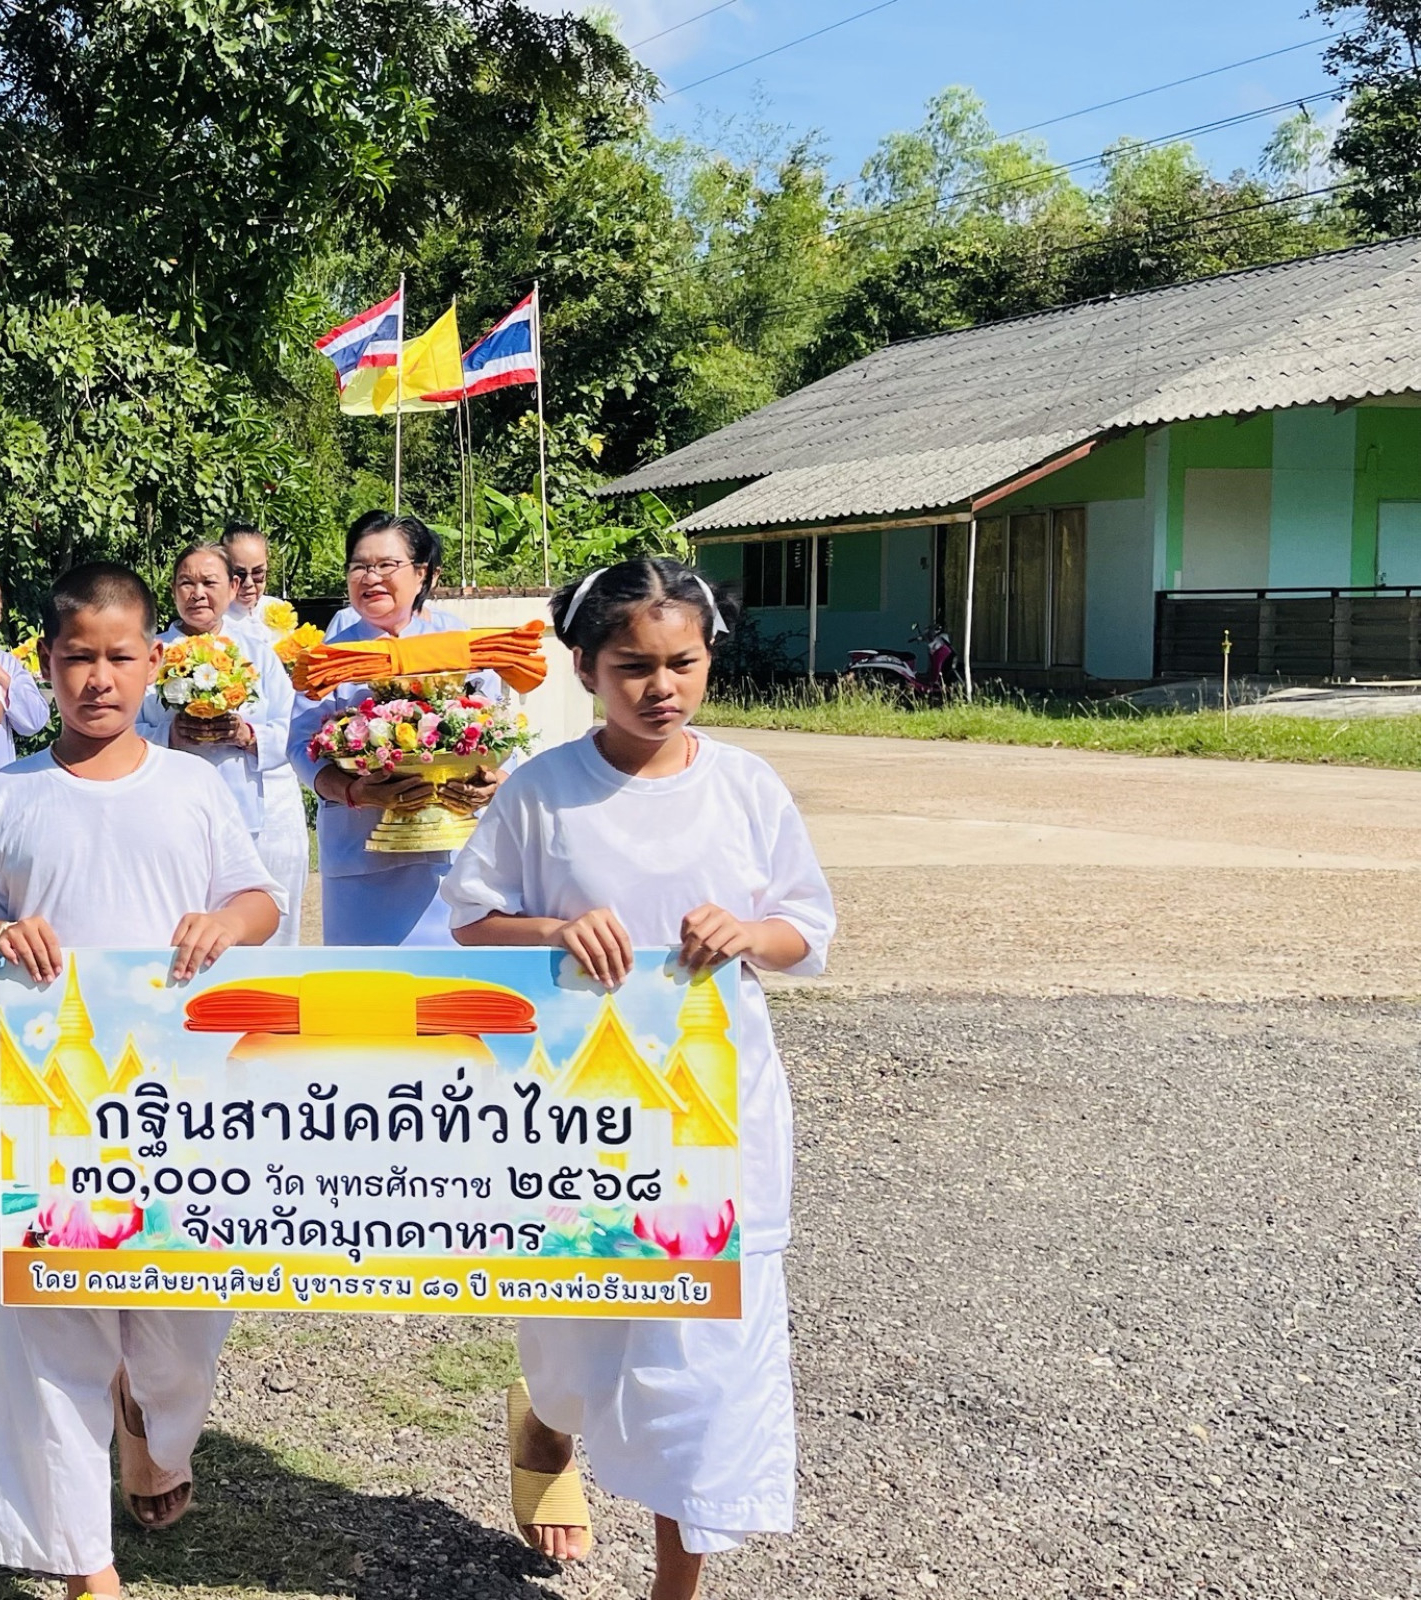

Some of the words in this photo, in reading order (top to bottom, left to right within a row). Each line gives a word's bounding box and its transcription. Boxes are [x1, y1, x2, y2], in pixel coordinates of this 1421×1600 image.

[95, 1066, 633, 1158] กฐินสามัคคีทั่วไทย
[71, 1165, 252, 1201] ๓๐,๐๐๐
[265, 1163, 305, 1196] วัด
[315, 1165, 492, 1209] พุทธศักราช
[507, 1164, 663, 1202] ๒๕๖๘
[182, 1204, 546, 1262] จังหวัดมุกดาหาร
[32, 1264, 77, 1289] โดย
[88, 1267, 281, 1300] คณะศิษยานุศิษย์
[292, 1275, 411, 1302] บูชาธรรม
[423, 1279, 459, 1298] ๘๑
[470, 1271, 488, 1298] ปี
[499, 1274, 709, 1302] หลวงพ่อธัมมชโย
